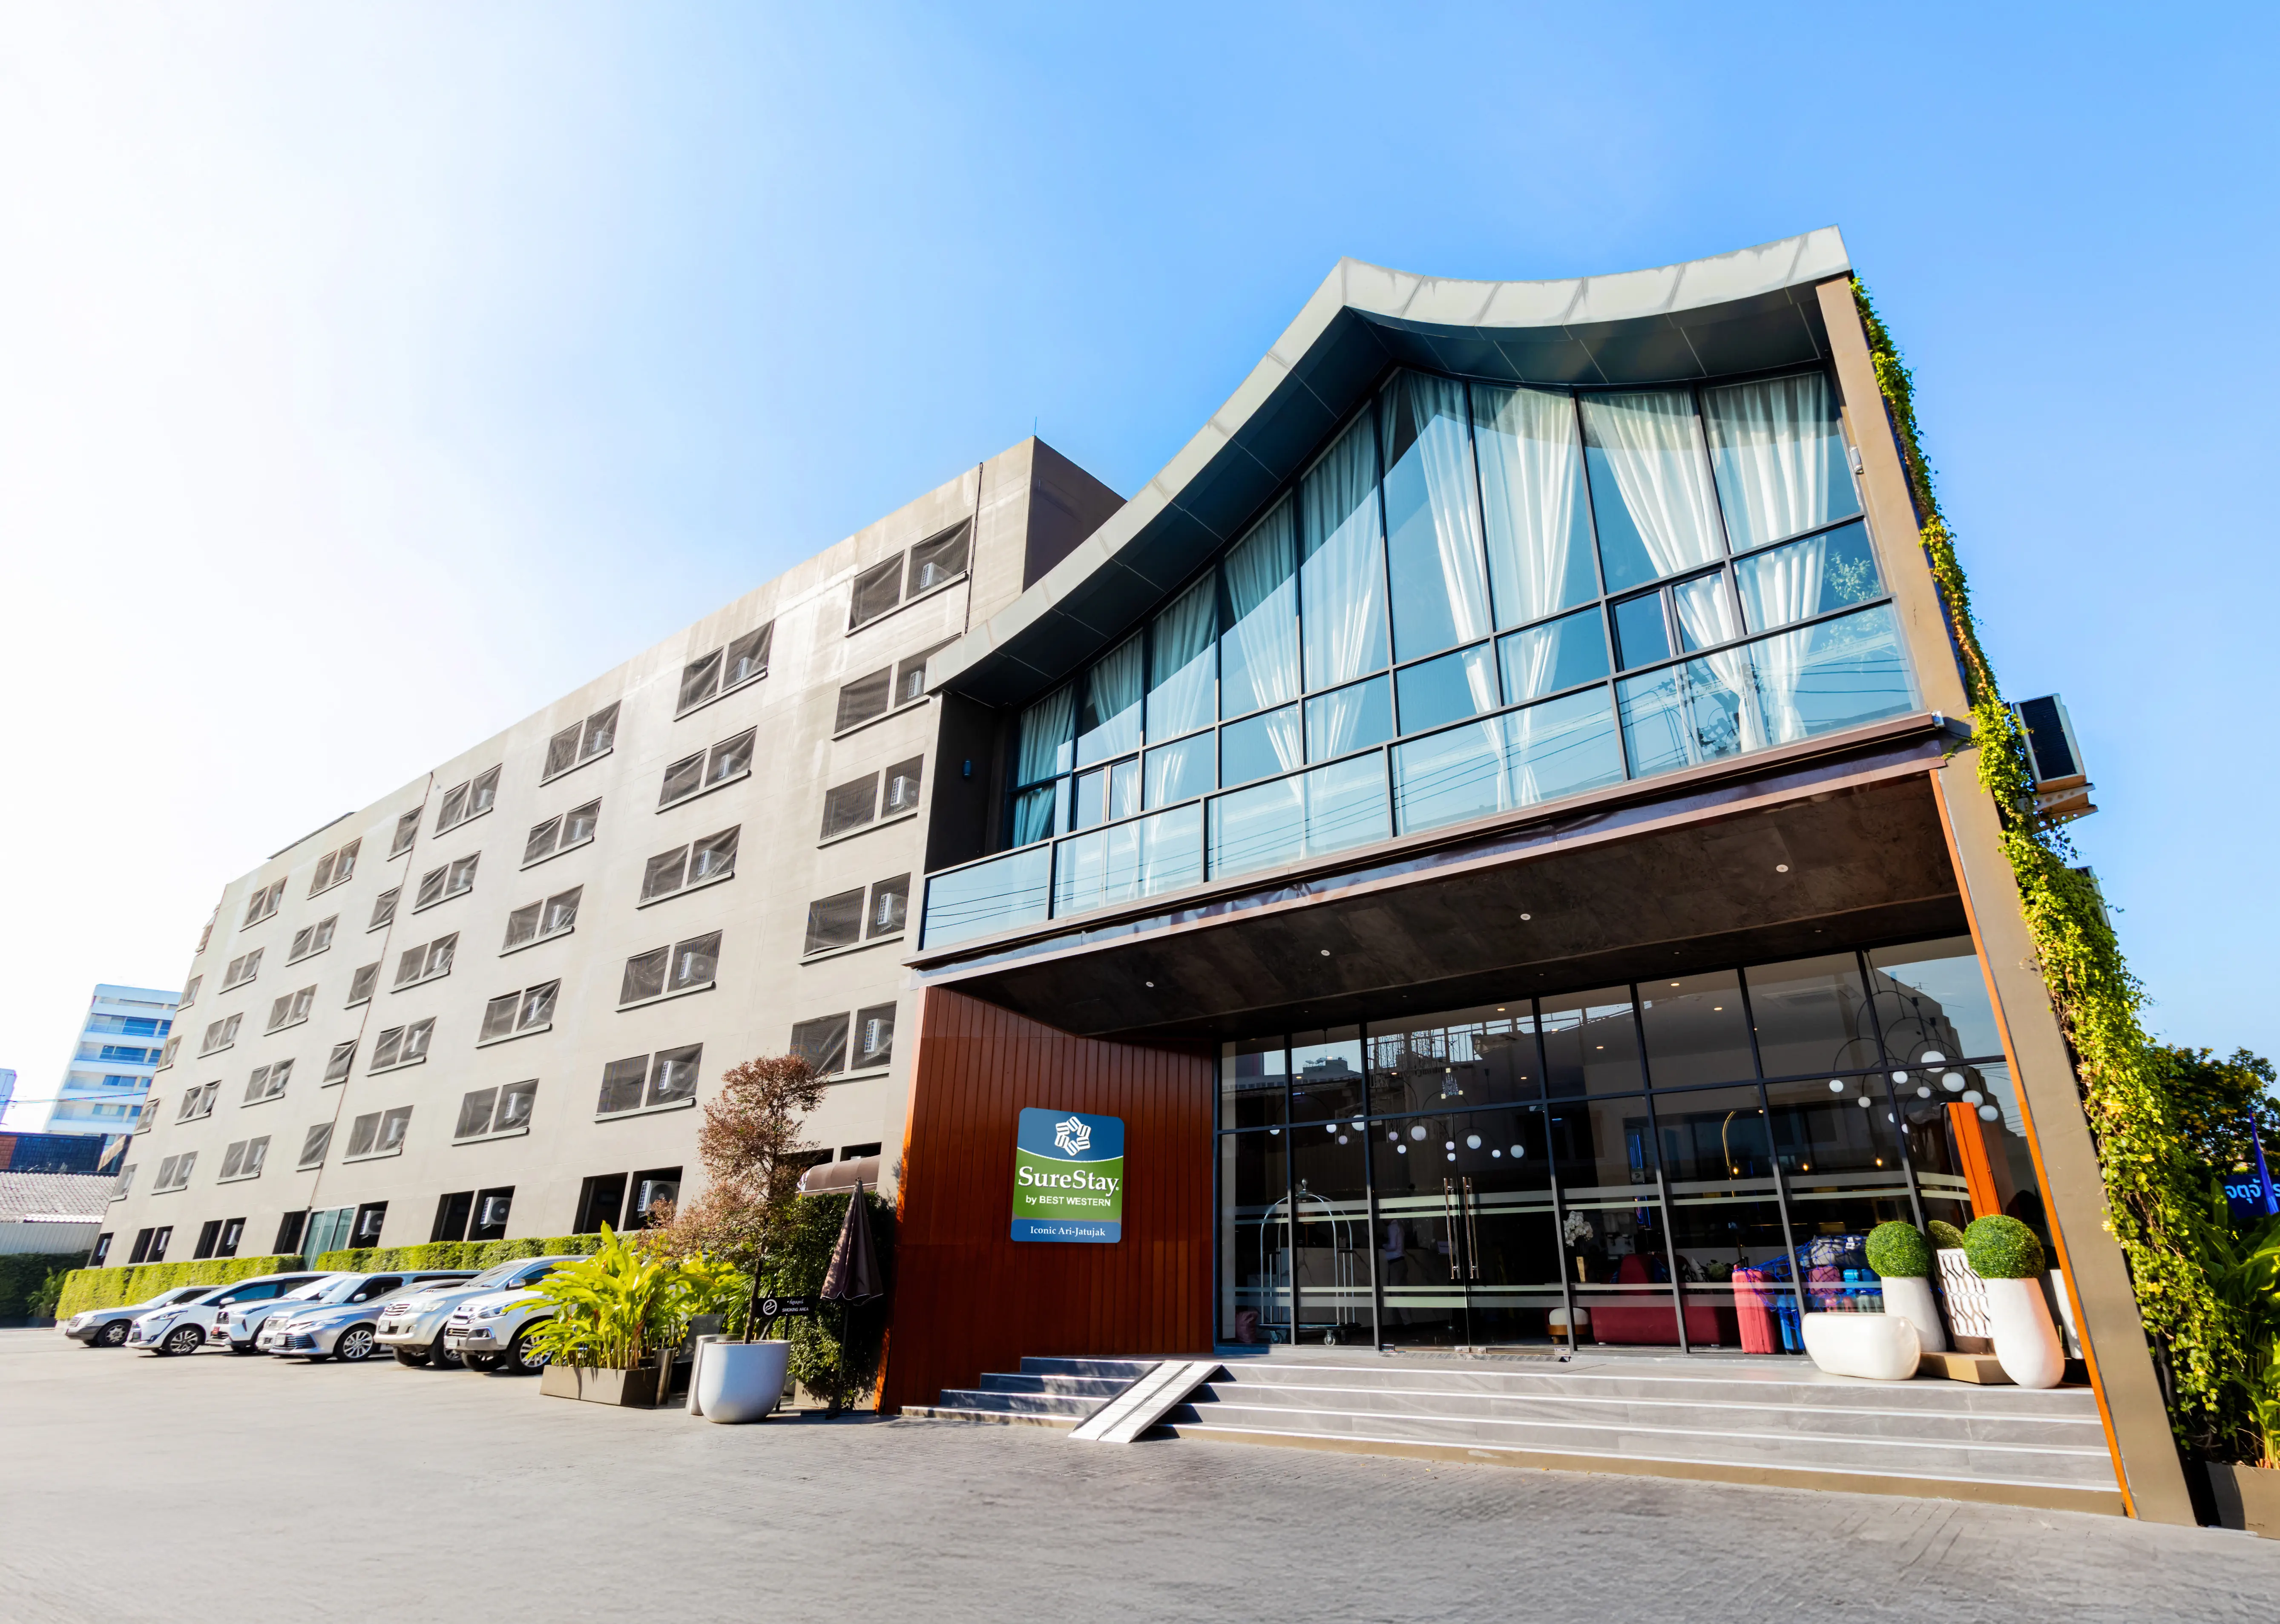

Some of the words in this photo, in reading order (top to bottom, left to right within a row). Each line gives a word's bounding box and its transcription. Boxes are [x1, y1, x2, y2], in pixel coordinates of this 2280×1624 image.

[1026, 1195, 1037, 1205] by
[1039, 1196, 1064, 1204] BEST
[1066, 1197, 1111, 1206] WESTERN
[1030, 1226, 1056, 1234] Iconic
[1058, 1227, 1106, 1238] Ari-Jatujak
